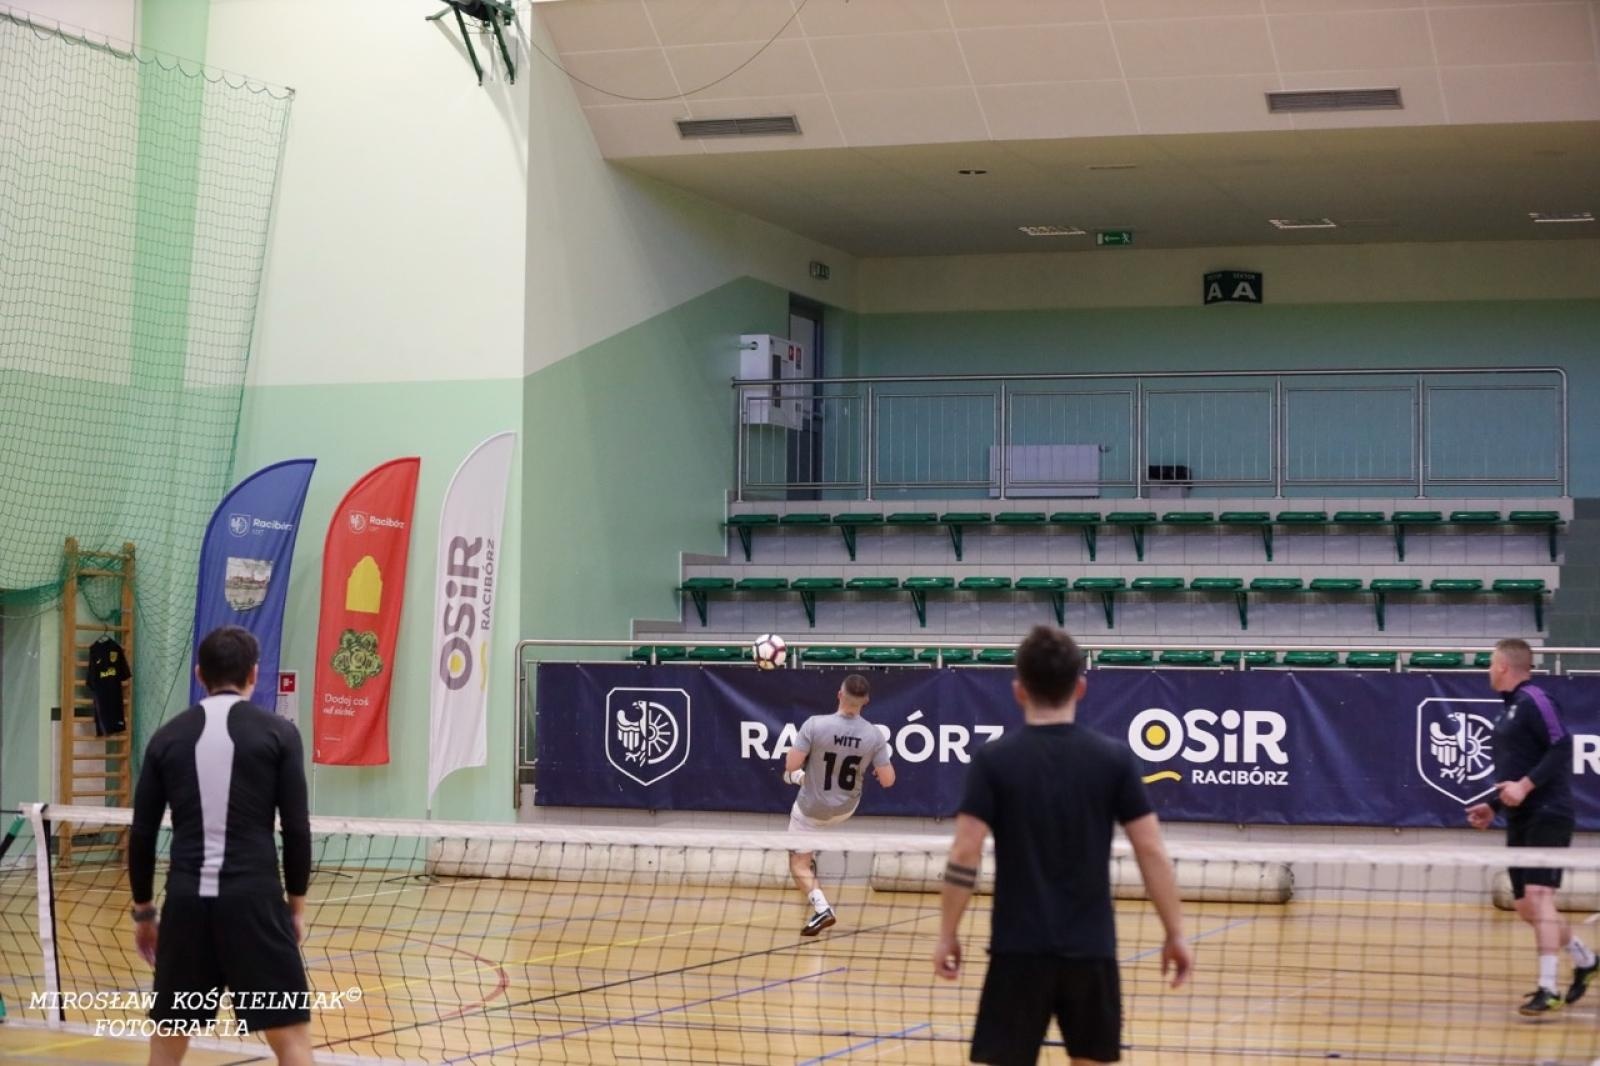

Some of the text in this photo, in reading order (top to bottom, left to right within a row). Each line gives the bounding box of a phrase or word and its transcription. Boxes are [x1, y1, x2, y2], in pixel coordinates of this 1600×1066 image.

[1207, 282, 1223, 301] A
[1232, 281, 1257, 300] A
[480, 538, 495, 631] RACIBÓRZ
[440, 536, 482, 691] OSiR
[833, 734, 862, 749] WITT
[1128, 708, 1289, 765] OSiR
[823, 752, 863, 791] 16
[1192, 766, 1289, 786] RACIBÓRZ
